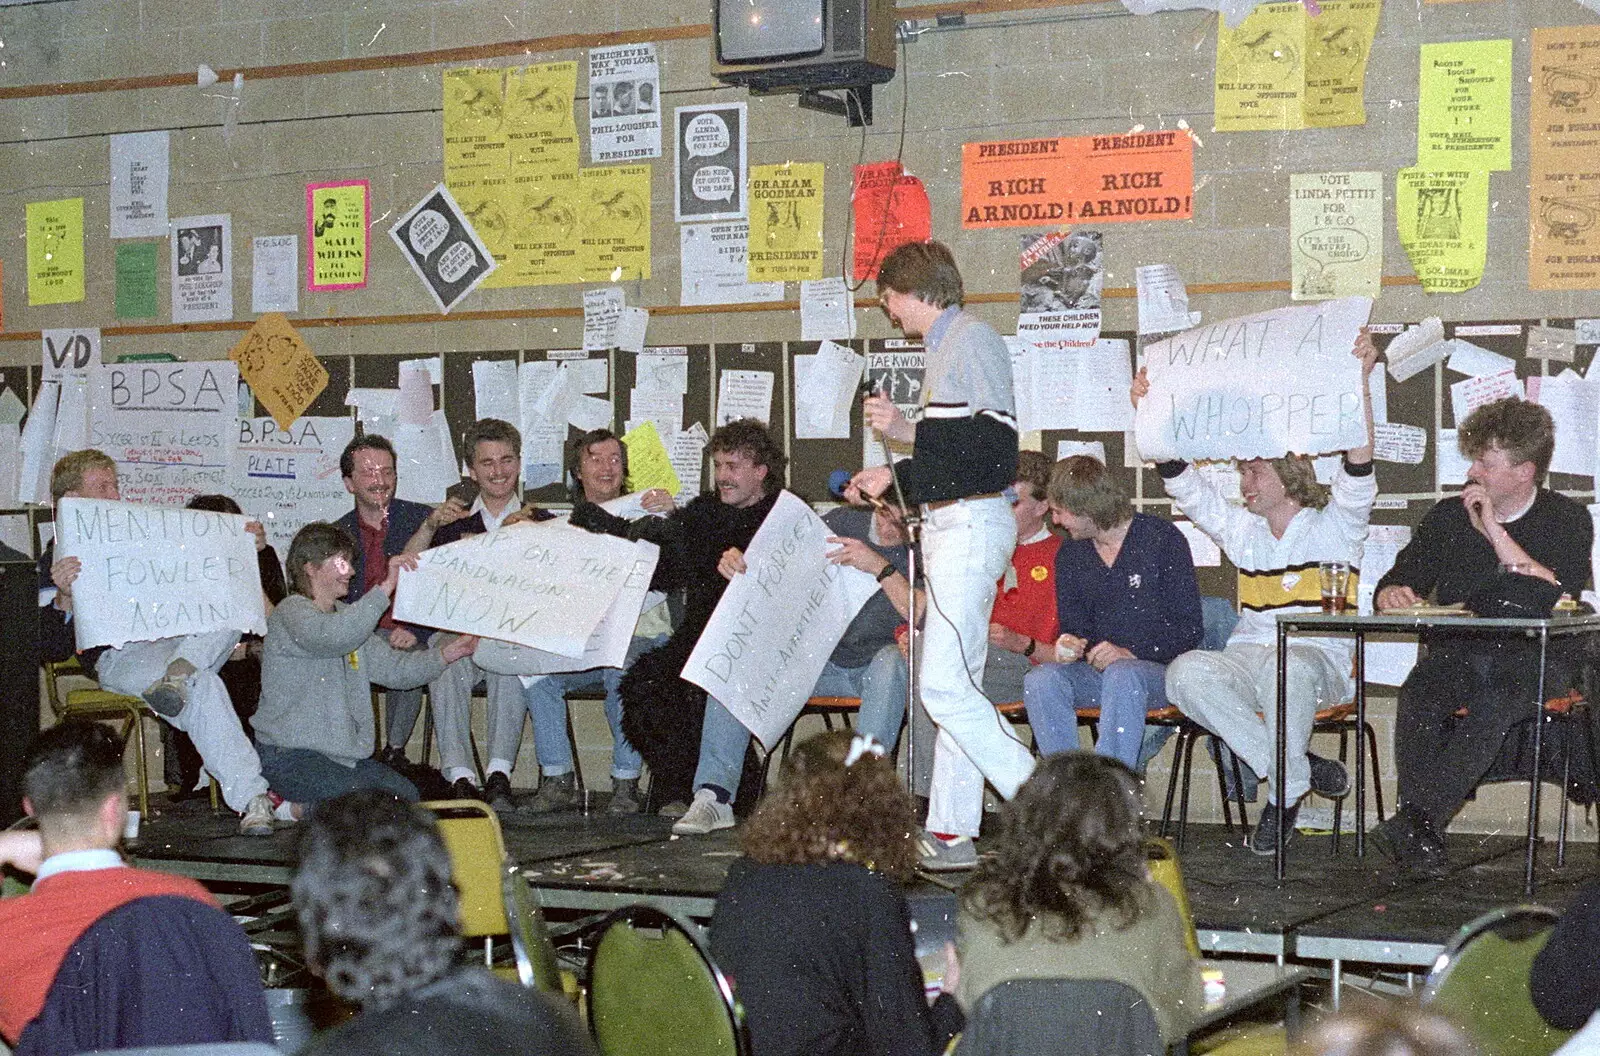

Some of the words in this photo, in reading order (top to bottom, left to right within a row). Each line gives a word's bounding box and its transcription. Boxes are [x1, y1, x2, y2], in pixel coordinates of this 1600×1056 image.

[591, 48, 649, 61] WHICHEVER
[592, 60, 609, 69] WAY
[592, 69, 603, 77] AT
[592, 125, 615, 135] PHIL
[616, 121, 659, 132] LOUGHER
[617, 135, 635, 143] FOR
[1092, 134, 1175, 151] PRESIDENT
[599, 148, 654, 160] PRESIDENT
[980, 141, 1059, 158] PRESIDENT
[754, 179, 813, 189] GRAHAM
[988, 177, 1046, 197] RICH
[1102, 172, 1163, 191] RICH
[1320, 175, 1350, 185] VOTE
[754, 189, 816, 199] GOODMAN
[1295, 189, 1332, 200] LINDA
[1336, 189, 1376, 200] PETTIT
[1323, 203, 1345, 213] FOR
[413, 215, 427, 229] VOTE
[415, 217, 435, 236] LINDA
[1314, 216, 1320, 225] I
[1324, 216, 1333, 225] &
[422, 238, 434, 249] FOR
[1022, 236, 1049, 259] FAMINE
[1023, 257, 1032, 266] IN
[1034, 235, 1061, 258] AFRICA
[438, 254, 450, 266] AND
[749, 250, 819, 261] PRESIDENT
[447, 266, 458, 277] THE
[458, 252, 473, 267] DARK
[1039, 314, 1061, 323] THESE
[1063, 312, 1100, 322] CHILDREN
[1040, 323, 1060, 331] YOUR
[1061, 322, 1081, 330] HELP
[1082, 322, 1099, 330] NOW
[1058, 340, 1091, 350] Children
[1169, 318, 1277, 366] WHAT
[1295, 314, 1324, 357] A
[46, 334, 91, 369] VD
[547, 351, 588, 359] WINDSURFING
[302, 353, 321, 377] VOTE
[294, 370, 314, 395] YOUNG
[1171, 391, 1361, 442] WHOPPER
[248, 458, 296, 474] PLATE
[74, 506, 238, 545] MENTION
[523, 544, 558, 568] ON
[580, 558, 620, 584] THE
[429, 548, 569, 598] BANDWAGON
[704, 599, 758, 684] DONT
[758, 512, 815, 599] FORGET
[428, 582, 540, 633] NOW
[131, 602, 230, 633] AGAIN
